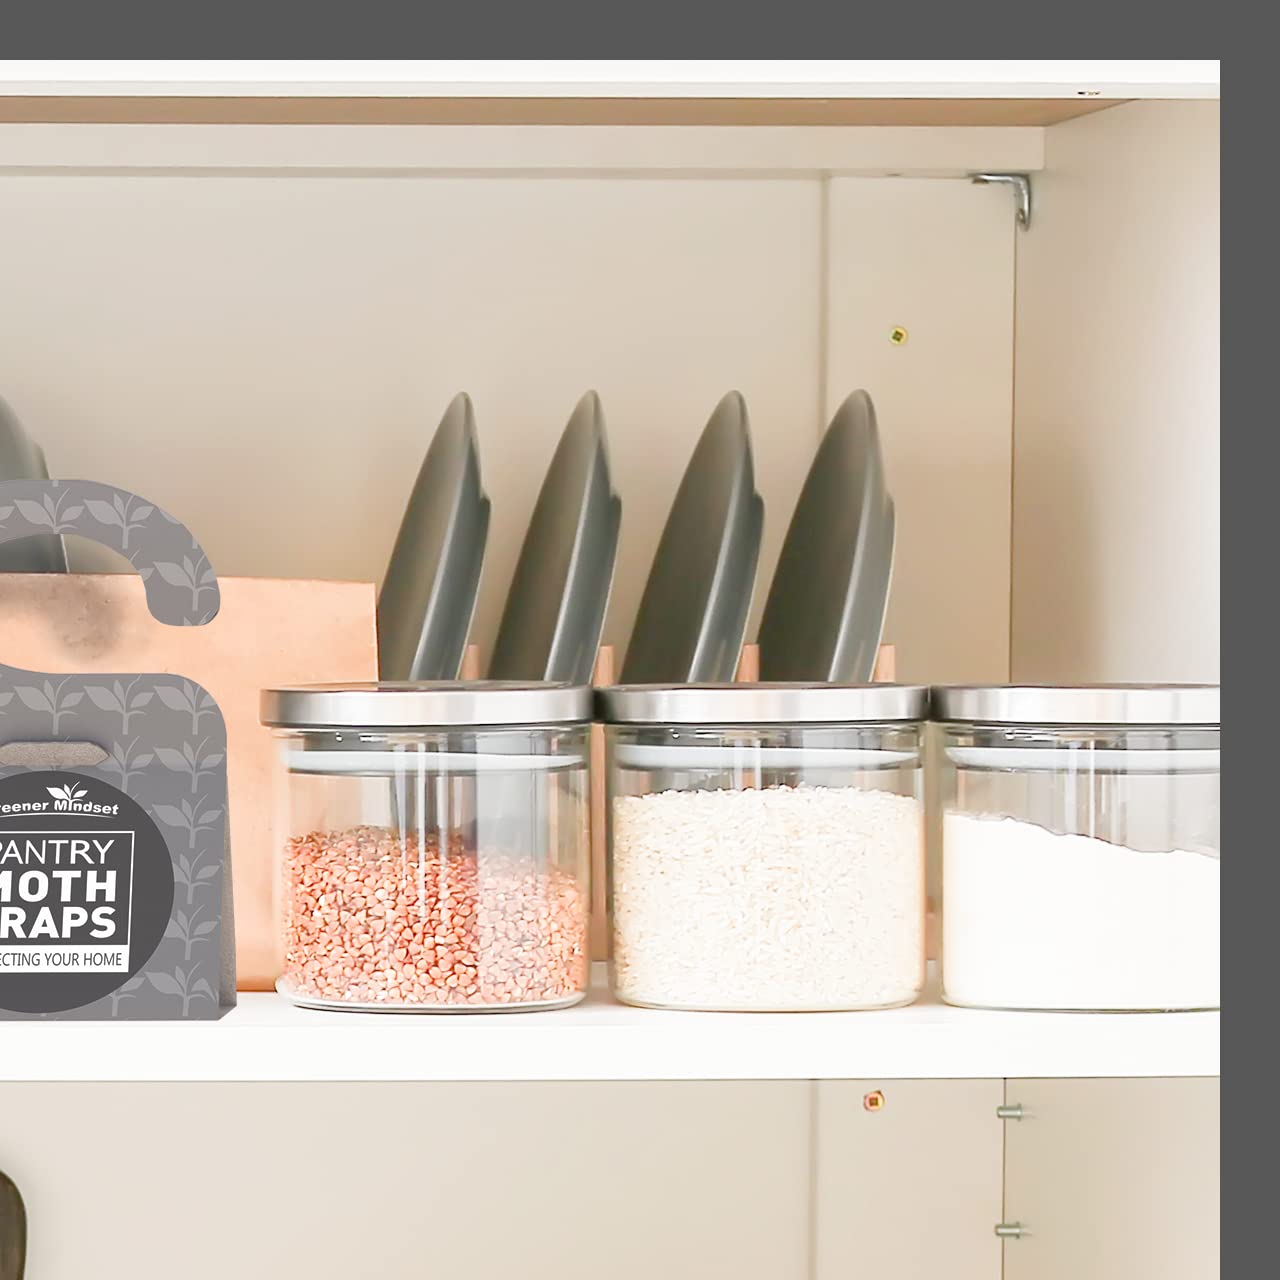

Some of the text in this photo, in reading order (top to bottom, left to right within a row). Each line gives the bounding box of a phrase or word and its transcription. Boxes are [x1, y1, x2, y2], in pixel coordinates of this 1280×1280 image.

[54, 799, 119, 815] Mindset
[44, 953, 79, 966] YOUR
[83, 953, 122, 966] HOME
